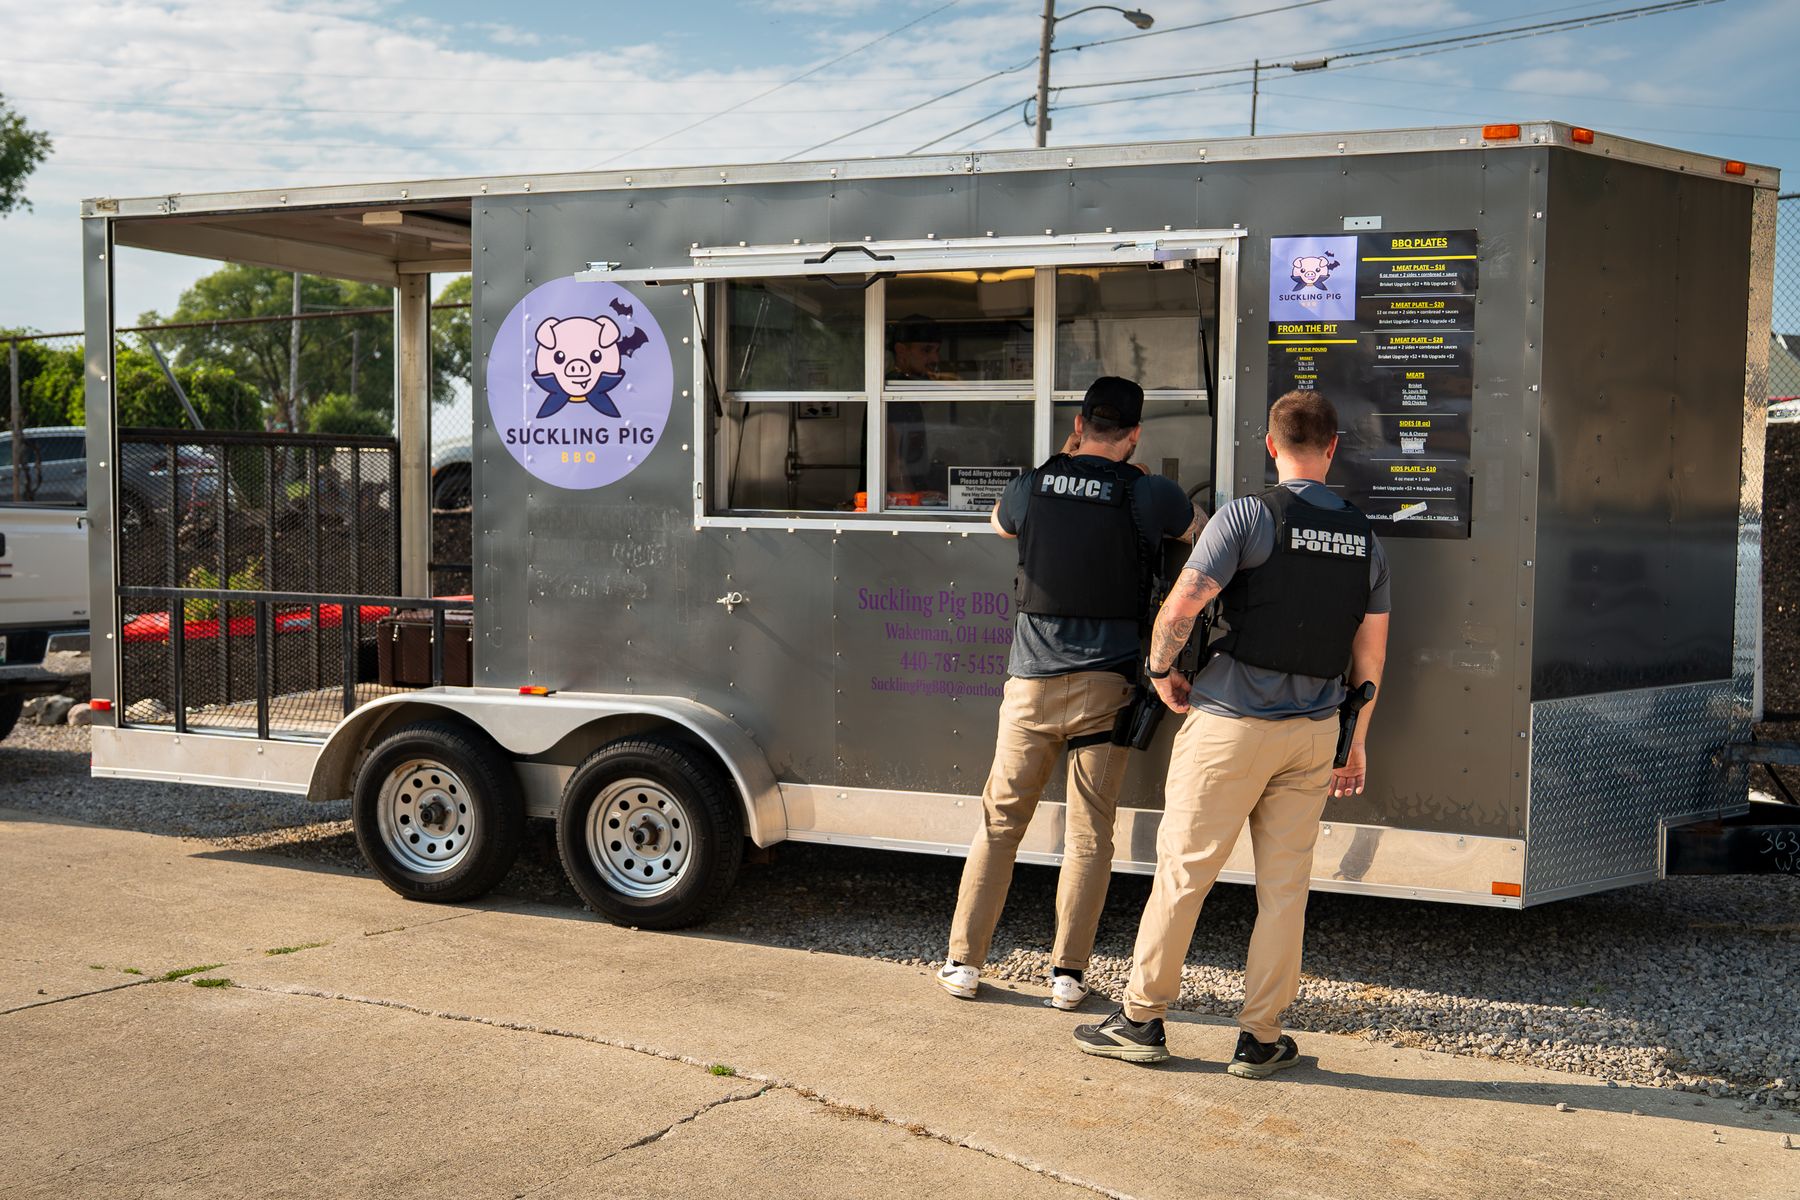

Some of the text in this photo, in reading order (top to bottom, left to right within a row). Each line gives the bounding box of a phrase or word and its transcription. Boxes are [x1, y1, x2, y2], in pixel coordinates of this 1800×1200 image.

[1392, 237, 1448, 248] BBQ PLATES
[1435, 263, 1446, 271] $16
[1279, 293, 1323, 301] SUCKLING
[1277, 324, 1338, 333] FROM THE PIT
[506, 428, 654, 445] SUCKLING PIG
[561, 451, 596, 464] BBQ
[972, 470, 992, 478] Allergy
[1040, 474, 1113, 501] POLICE
[1291, 527, 1366, 547] LORAIN
[1291, 538, 1366, 557] POLICE
[858, 587, 1009, 621] Suckling Pig BBQ
[885, 622, 1013, 645] Wakeman, OH 4488
[899, 651, 1005, 676] 440-787-5453
